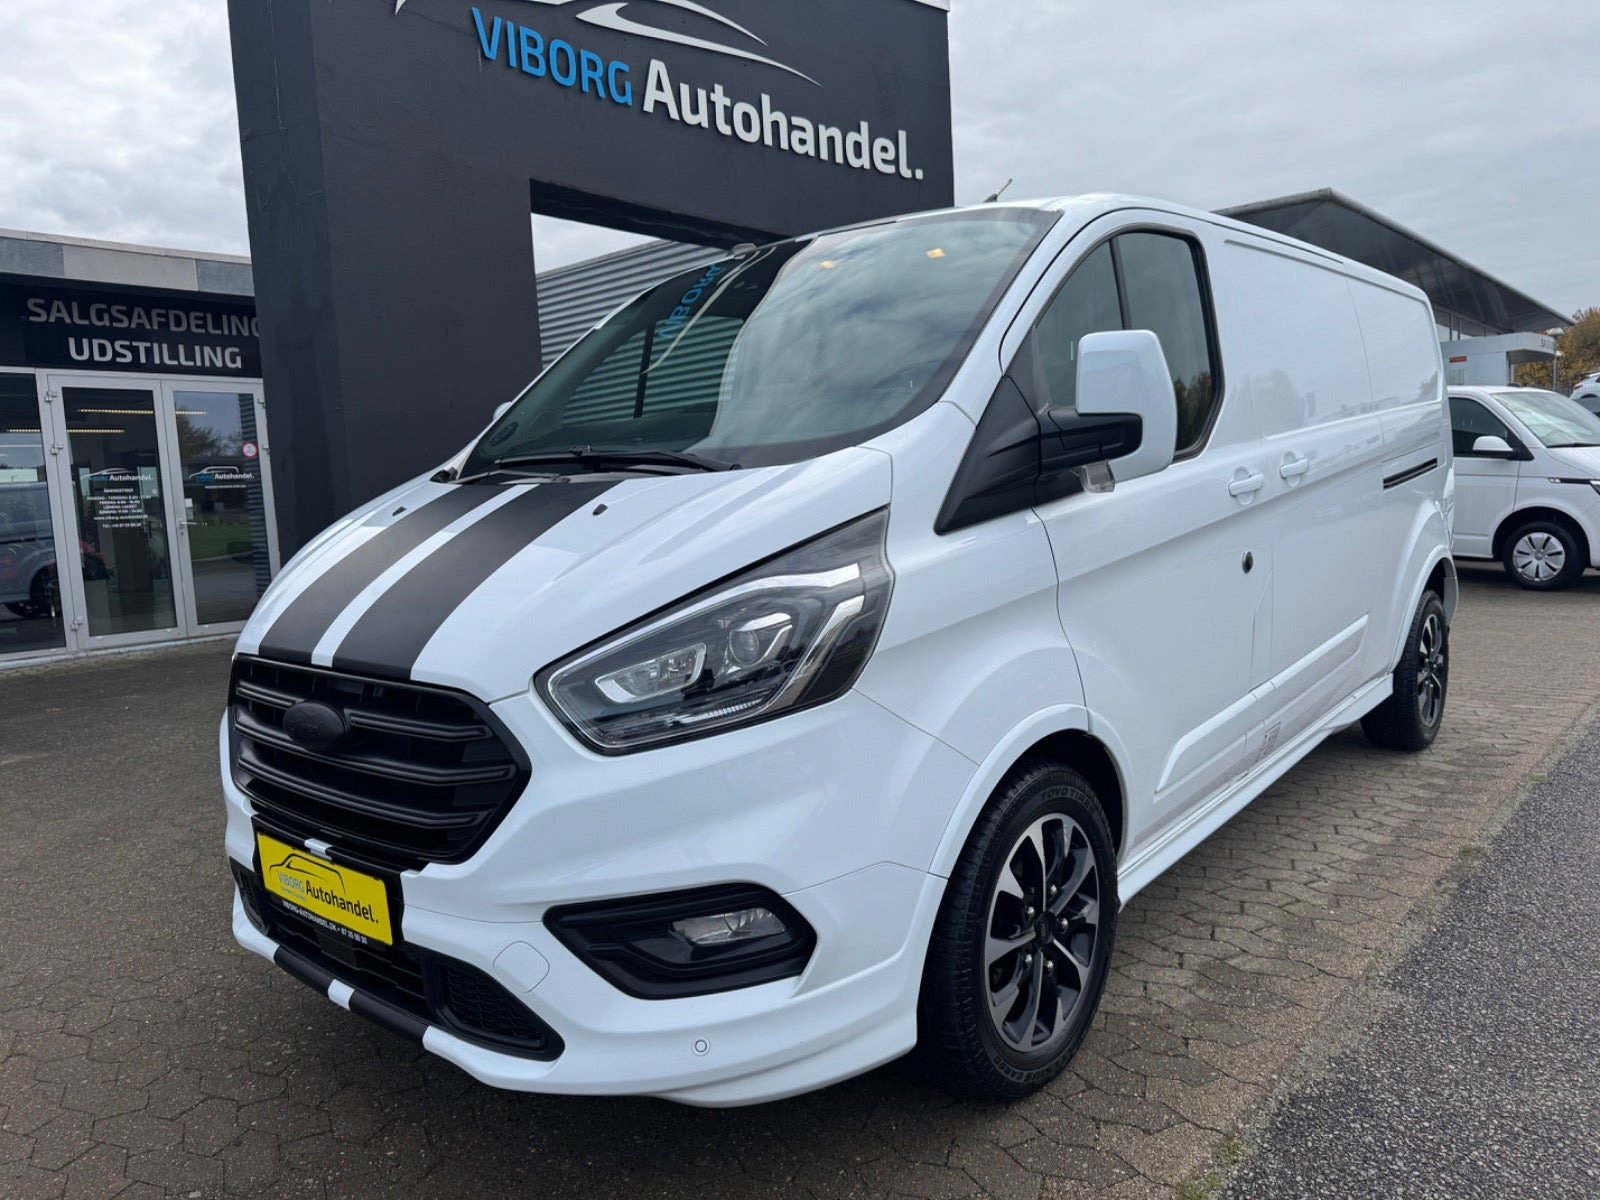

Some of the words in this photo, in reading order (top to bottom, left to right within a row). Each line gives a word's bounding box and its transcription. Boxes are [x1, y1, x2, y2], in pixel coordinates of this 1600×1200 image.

[472, 7, 633, 107] VIBORG
[643, 58, 924, 180] Autohandel.
[68, 336, 242, 369] UDSTILLING
[306, 879, 379, 924] Autohandel.
